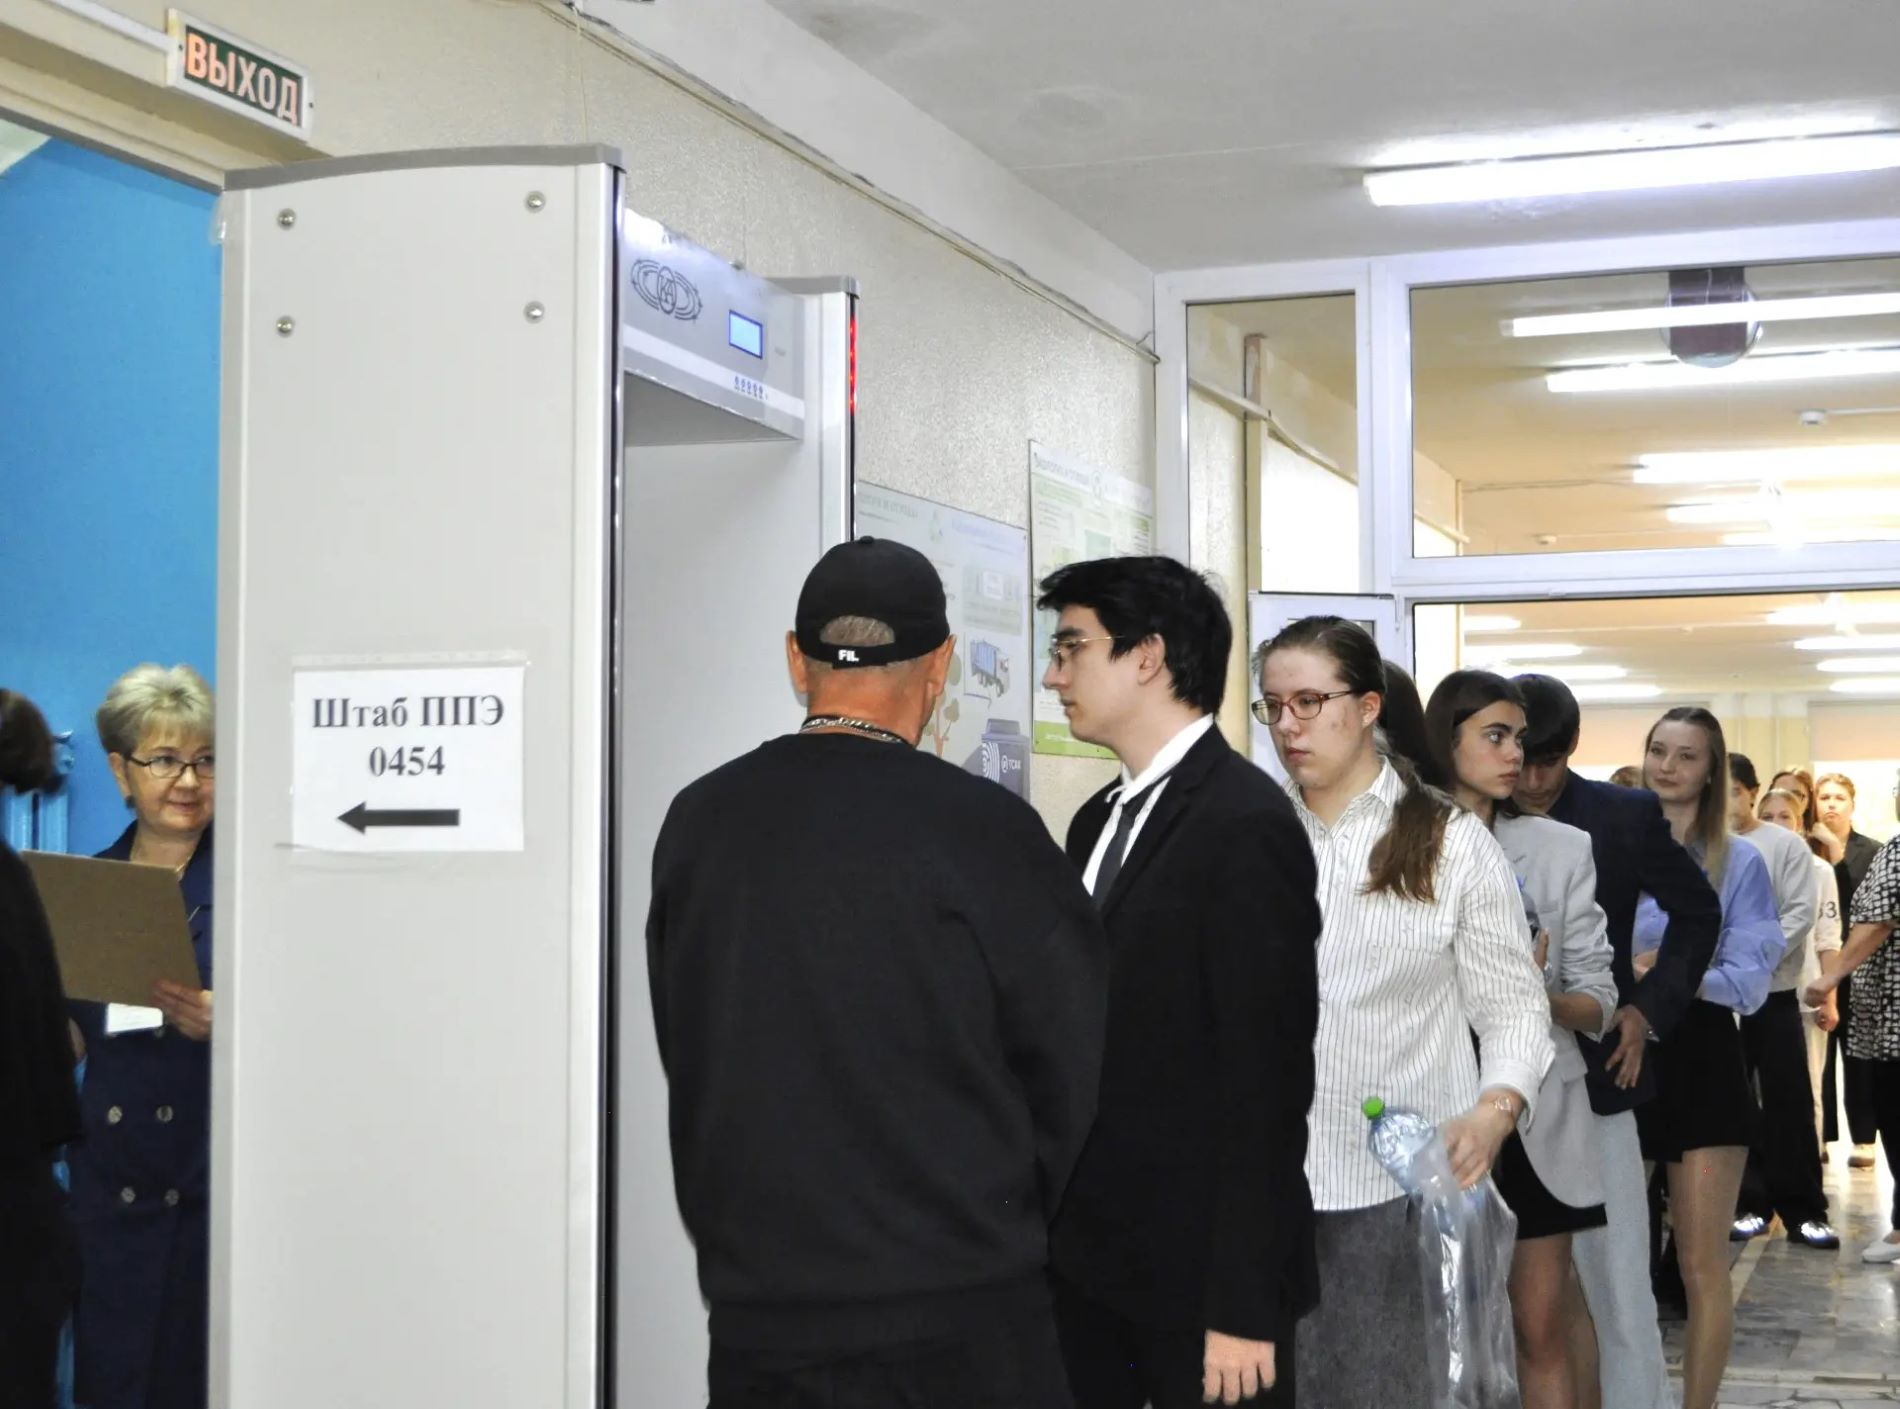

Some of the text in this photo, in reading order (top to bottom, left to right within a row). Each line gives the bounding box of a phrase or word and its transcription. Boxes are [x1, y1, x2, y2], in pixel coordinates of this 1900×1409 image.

[187, 33, 298, 126] ВЫХОД
[312, 695, 504, 728] Штаб ППЭ
[369, 745, 445, 777] 0454
